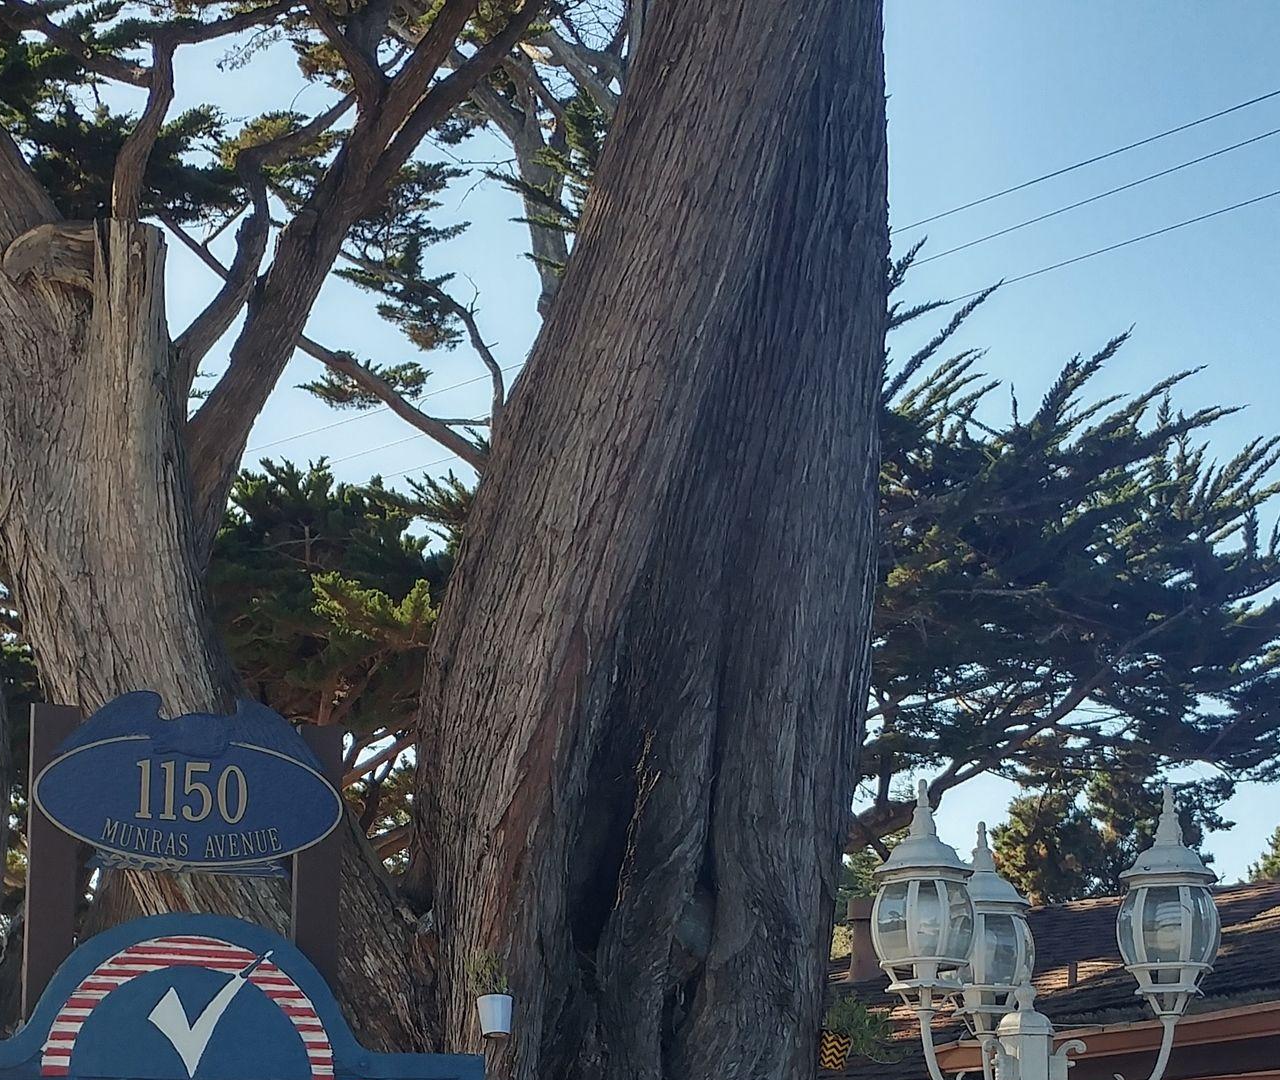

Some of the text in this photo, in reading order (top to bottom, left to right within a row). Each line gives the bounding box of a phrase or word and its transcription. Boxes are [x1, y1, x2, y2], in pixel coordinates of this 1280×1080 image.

[135, 759, 248, 824] 1150
[100, 817, 282, 858] MUNRAS AVENUE
